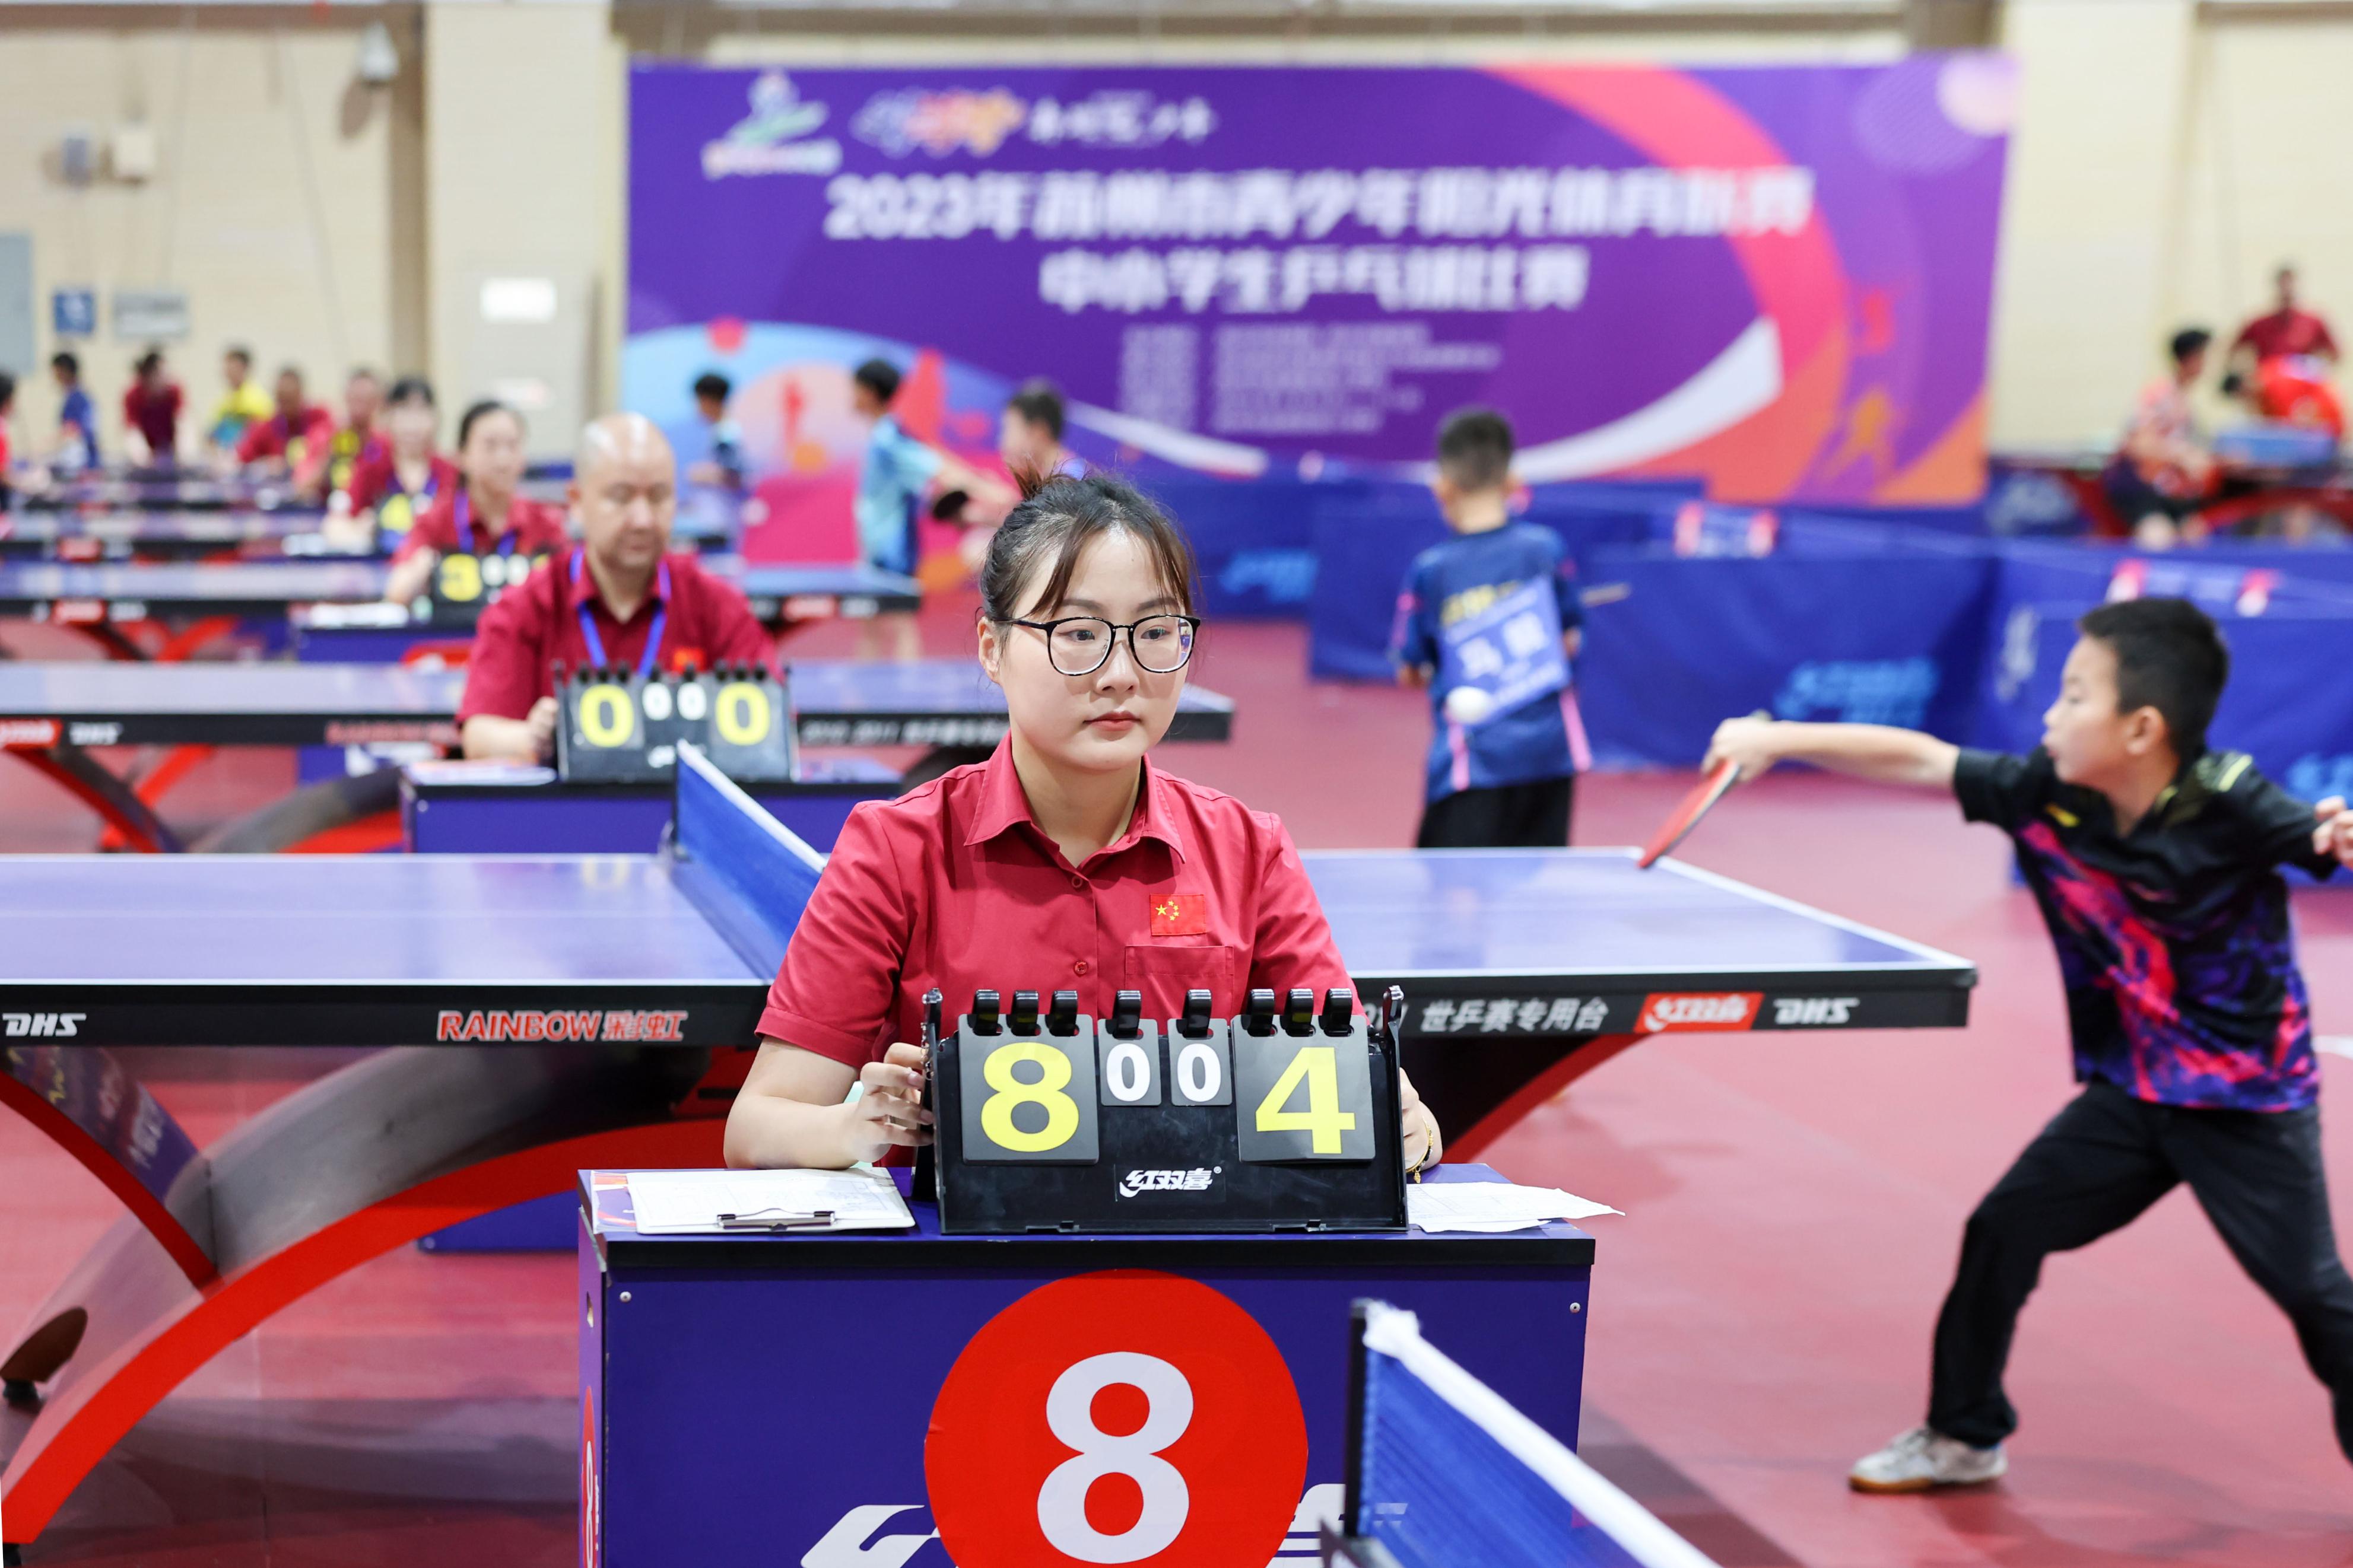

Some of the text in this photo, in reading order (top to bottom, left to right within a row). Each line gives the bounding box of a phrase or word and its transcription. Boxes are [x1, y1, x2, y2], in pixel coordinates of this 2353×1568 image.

[580, 684, 634, 747] 0
[716, 682, 770, 746] 0
[2, 1012, 87, 1037] DHS
[437, 1010, 688, 1041] RAINBOW 彩虹
[1420, 997, 1608, 1032] 世乒赛专用台
[1773, 997, 1860, 1025] DHS
[980, 1042, 1356, 1154] 8 0 0 4
[1119, 1168, 1213, 1198] 红双喜
[1036, 1351, 1194, 1565] 8
